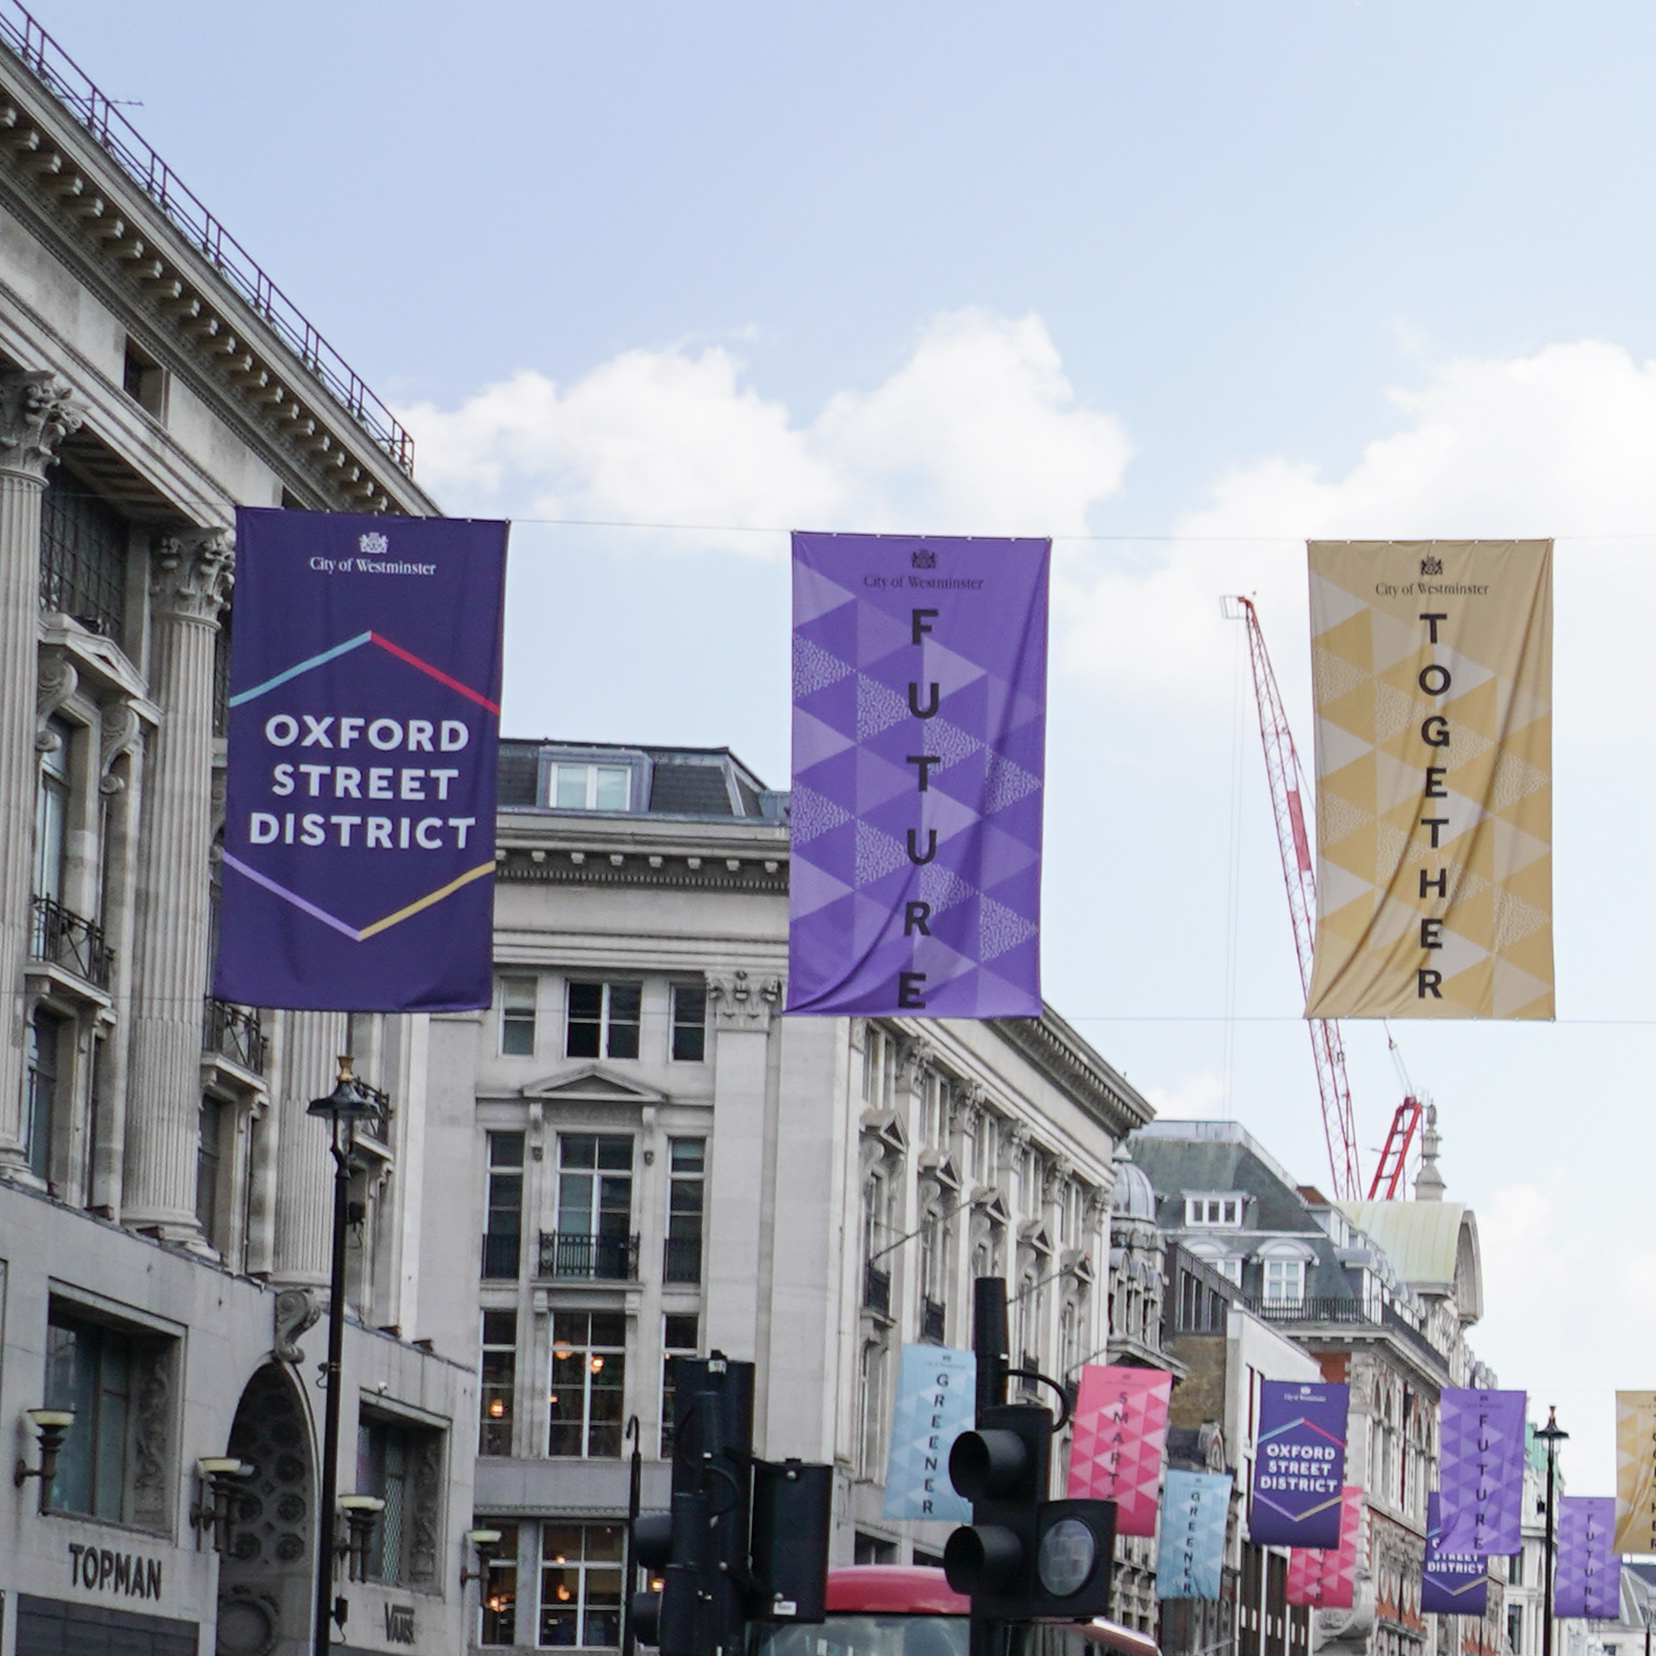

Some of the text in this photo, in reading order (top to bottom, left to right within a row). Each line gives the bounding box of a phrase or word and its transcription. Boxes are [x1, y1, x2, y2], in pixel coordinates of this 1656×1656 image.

[309, 555, 436, 575] City of Westminster
[863, 574, 984, 591] City of Westminster
[1375, 581, 1489, 597] City of Westminster
[265, 714, 470, 752] OXFORD
[272, 763, 459, 800] STREET
[898, 608, 941, 1009] FUTURE
[1418, 613, 1452, 999] TOGETHER
[250, 812, 476, 849] DISTRICT
[922, 1373, 949, 1514] GREENER
[1106, 1392, 1128, 1499] SMART
[1266, 1443, 1336, 1461] OXFORD
[1260, 1475, 1338, 1493] DISTRICT
[1268, 1460, 1331, 1477] STREET
[1473, 1414, 1489, 1550] FUTURE
[69, 1542, 162, 1601] TOPMAN
[1427, 1562, 1485, 1575] DISTRICT
